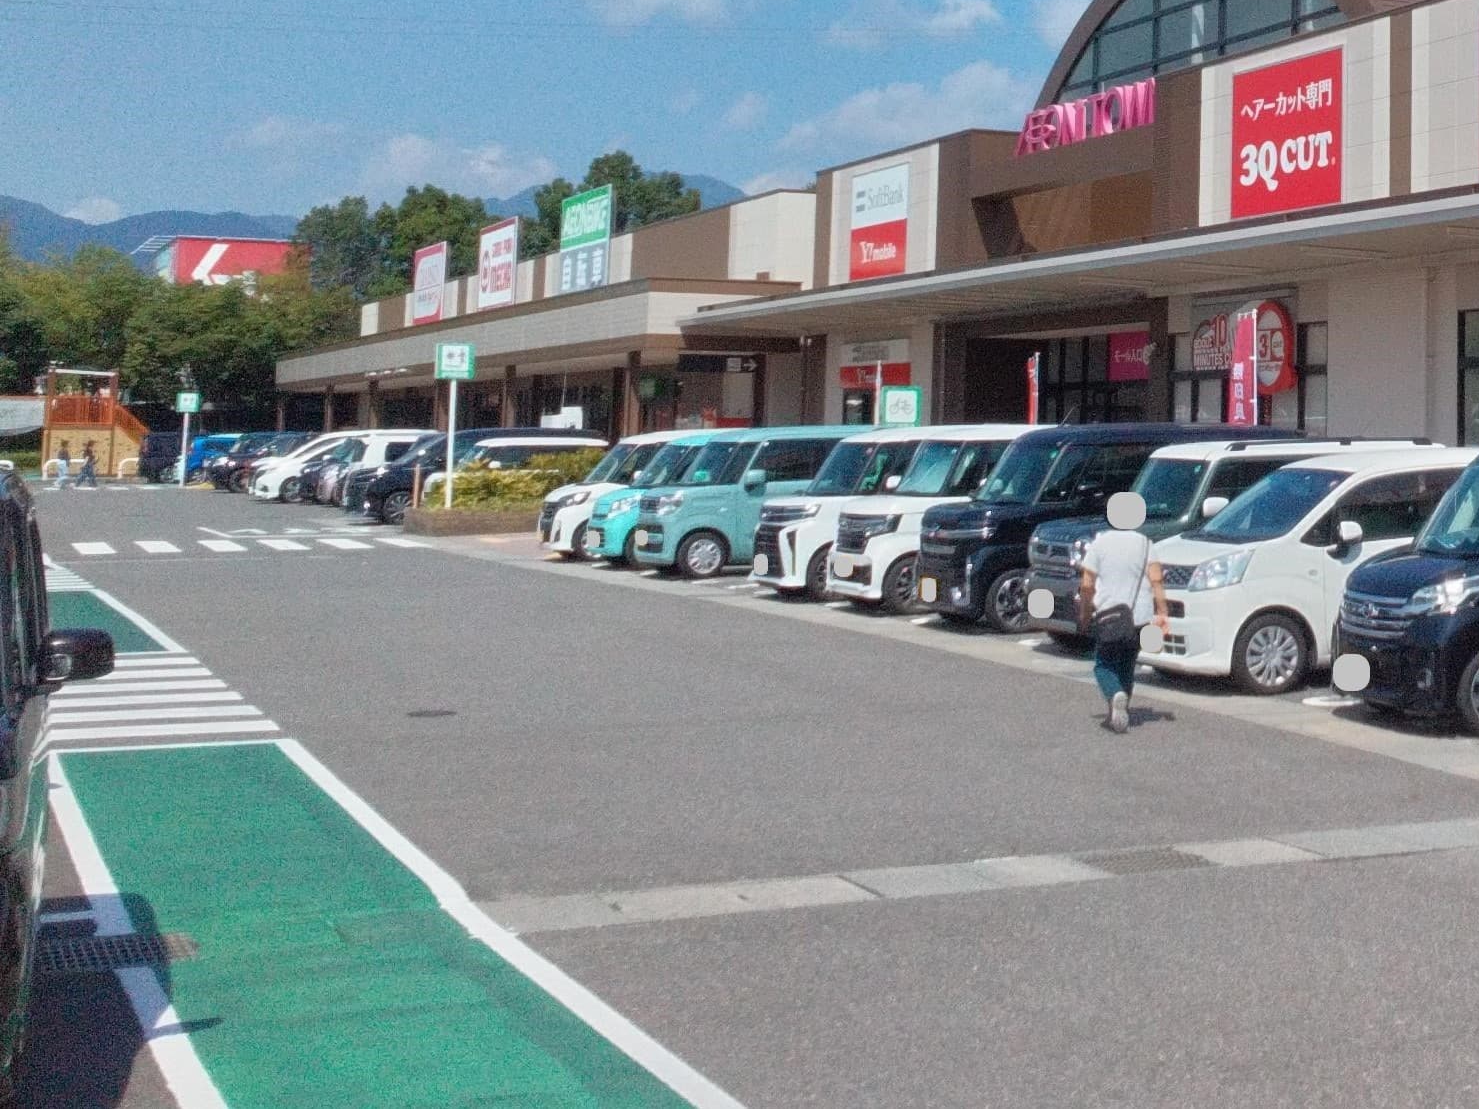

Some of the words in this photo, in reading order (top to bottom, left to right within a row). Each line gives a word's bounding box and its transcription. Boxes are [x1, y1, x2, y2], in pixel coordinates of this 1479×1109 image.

[1240, 78, 1333, 122] ヘアーカット専門
